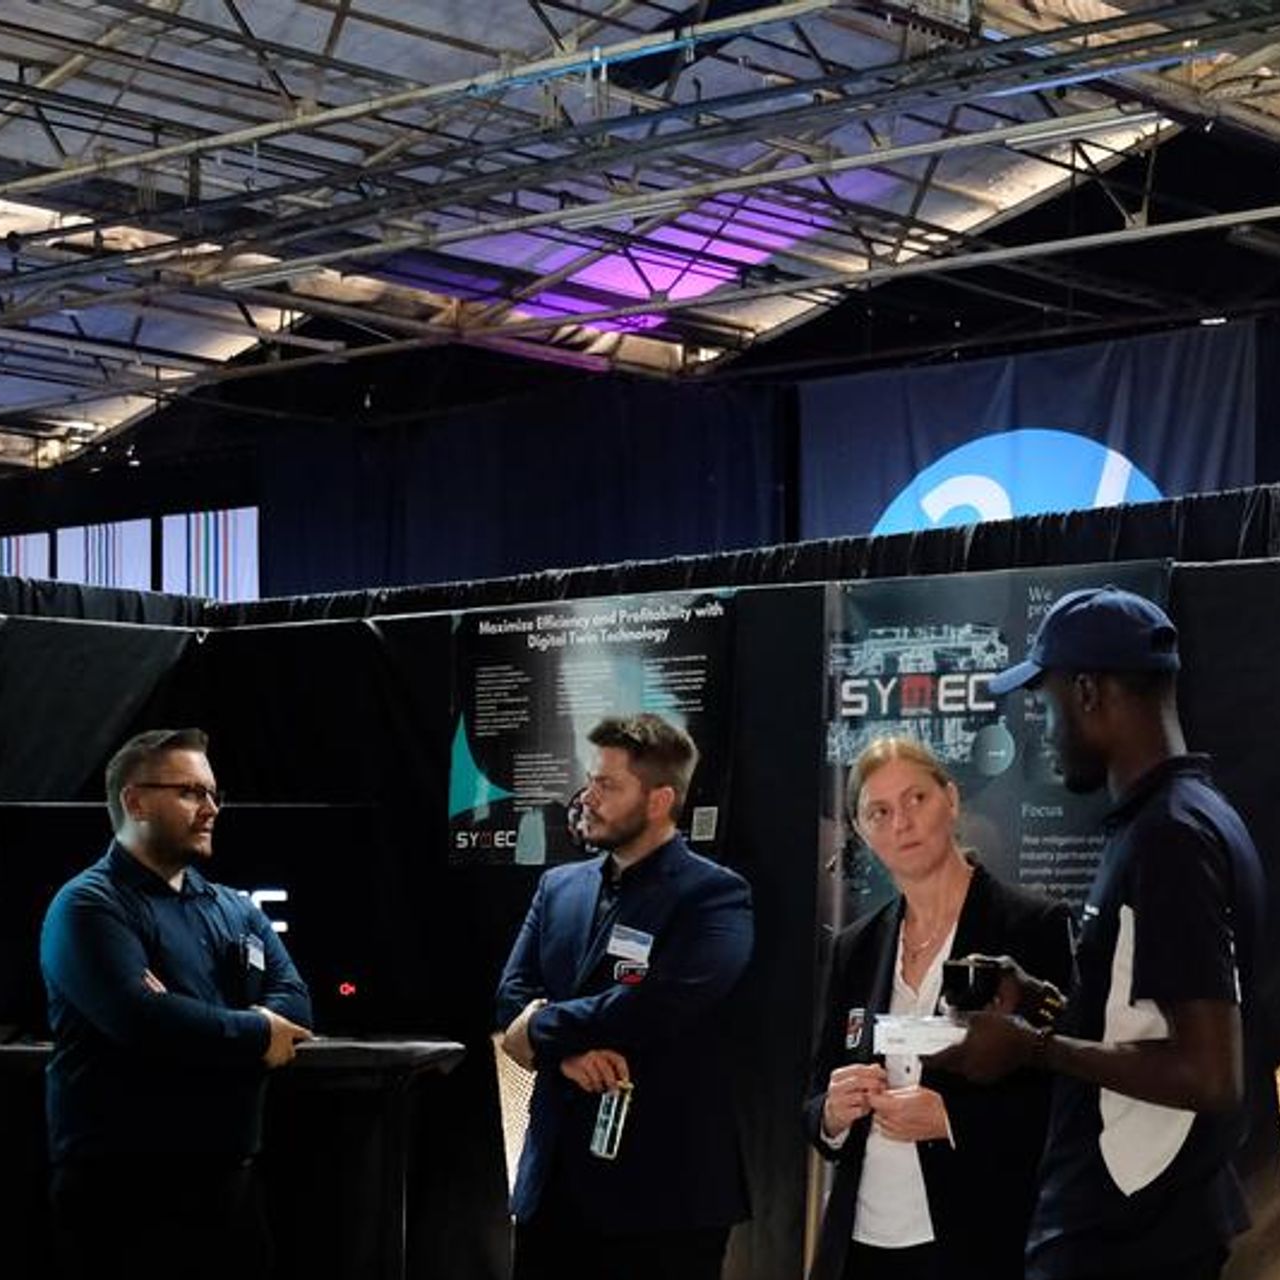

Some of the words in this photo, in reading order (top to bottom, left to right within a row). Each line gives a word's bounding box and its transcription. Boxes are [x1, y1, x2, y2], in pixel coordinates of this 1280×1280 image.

[479, 618, 533, 636] Maximize
[536, 613, 590, 632] Efficiency
[592, 609, 617, 625] and
[619, 604, 692, 625] Profitability
[695, 601, 724, 618] with
[528, 631, 566, 652] Digital
[569, 629, 599, 646] Twin
[601, 624, 670, 645] Technology
[841, 672, 997, 717] SYMEC
[1022, 802, 1063, 818] Focus
